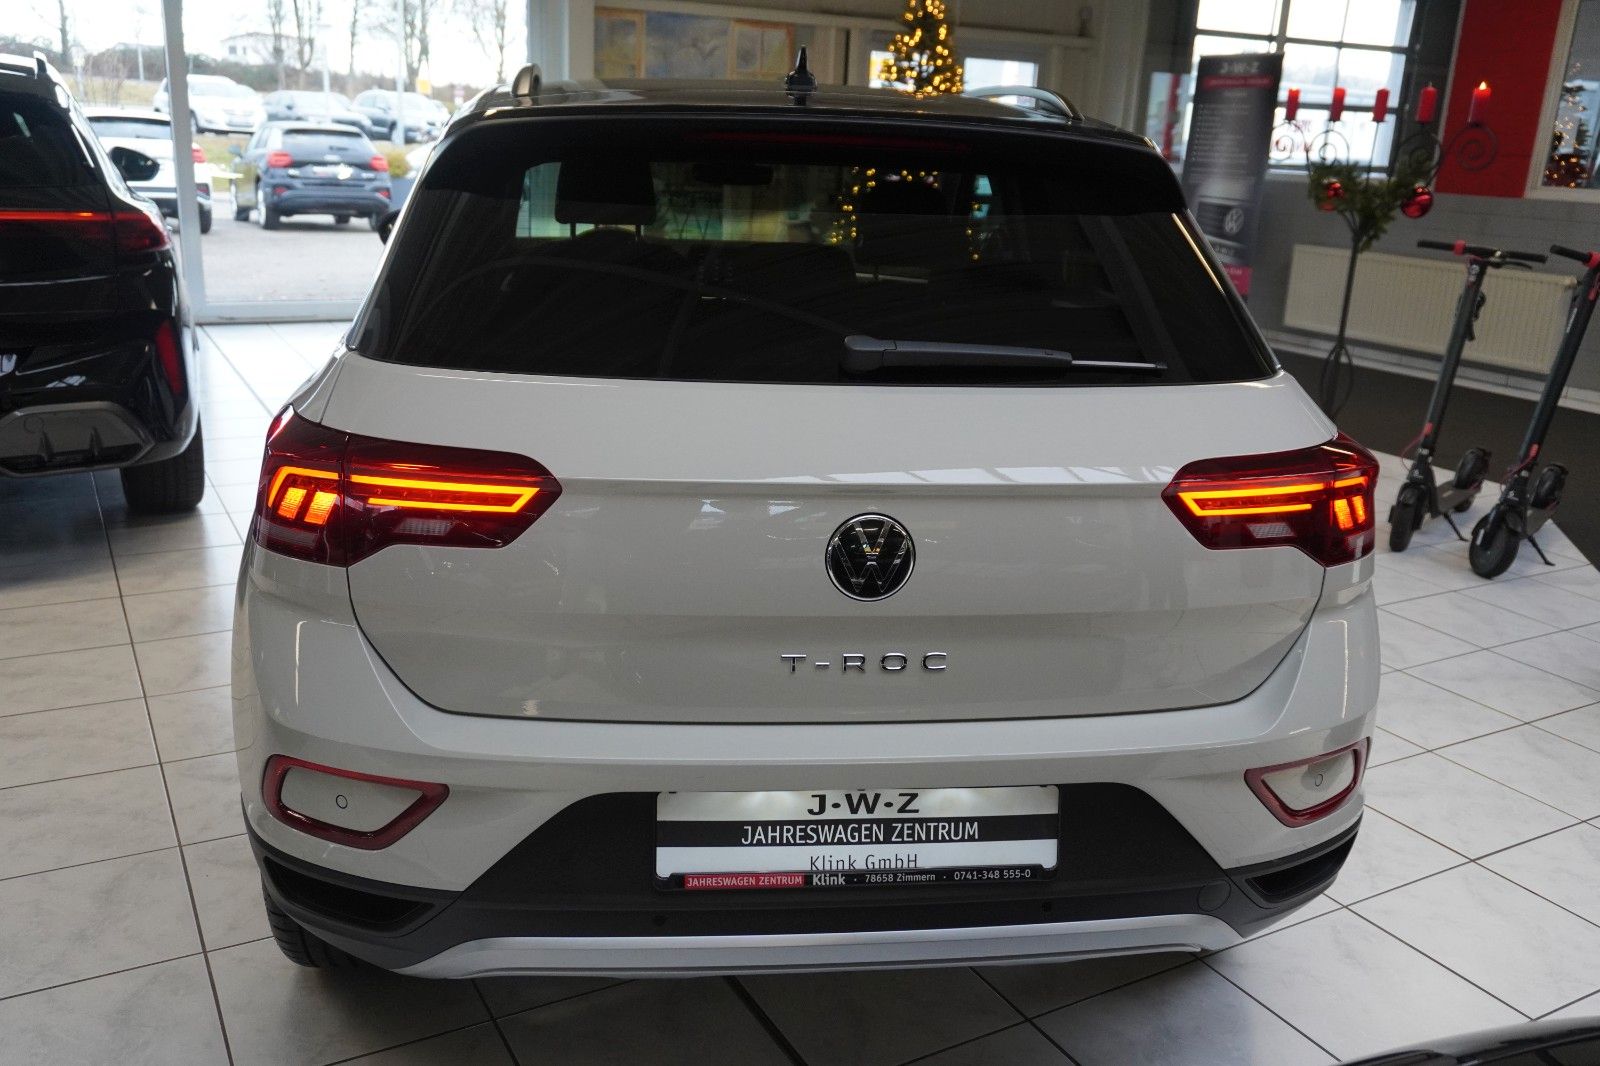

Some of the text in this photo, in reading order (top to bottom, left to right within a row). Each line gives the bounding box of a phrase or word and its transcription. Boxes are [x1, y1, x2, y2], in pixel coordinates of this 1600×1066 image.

[781, 652, 947, 672] T-ROC
[741, 821, 979, 845] JAHRESWAGEN ZENTRUM
[810, 853, 918, 871] Klink GmbH
[687, 868, 1031, 887] JAHRESWAGEN ZENTRUM Klink 78658 Zimmern 0741-348 555-0
